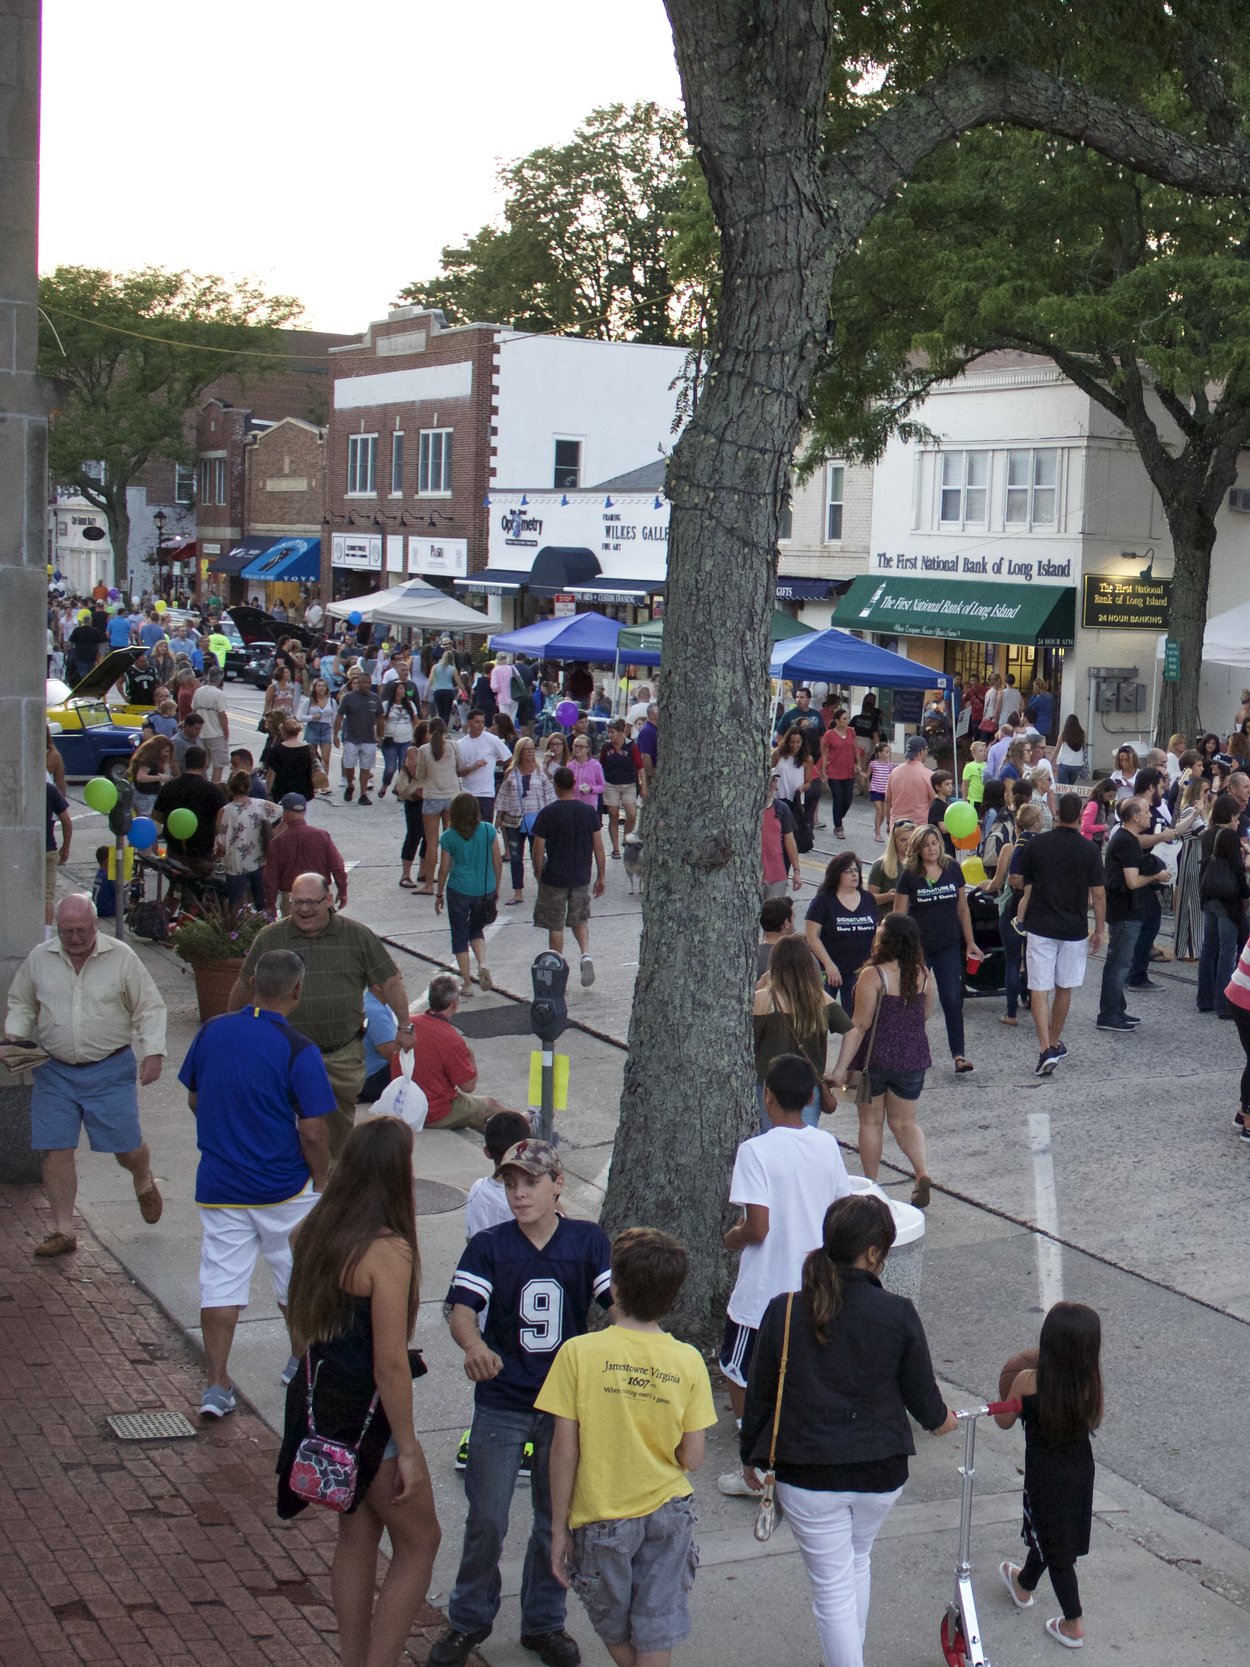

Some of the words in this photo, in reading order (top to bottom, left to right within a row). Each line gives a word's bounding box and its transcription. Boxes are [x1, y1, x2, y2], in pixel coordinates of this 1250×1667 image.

[602, 514, 621, 522] FRAMING
[605, 525, 636, 540] WILKES
[602, 542, 611, 550] FINE
[612, 543, 622, 551] ART
[877, 552, 893, 569] The
[896, 554, 918, 570] First
[922, 555, 959, 573] National
[962, 556, 988, 574] Bank
[992, 557, 1004, 574] of
[1008, 559, 1033, 582] Long
[1037, 558, 1071, 578] Island
[776, 586, 793, 597] GIFTS
[1099, 582, 1114, 593] The
[1114, 583, 1132, 593] First
[1135, 584, 1164, 594] National
[598, 594, 616, 602] CUSTOM
[616, 594, 636, 603] FRAMING
[1094, 594, 1112, 604] Bank
[1116, 594, 1124, 604] of
[1126, 596, 1144, 607] Long
[1146, 596, 1168, 606] Island
[880, 596, 896, 609] The
[894, 596, 913, 611] First
[912, 598, 944, 614] National
[940, 600, 963, 615] Bank
[961, 600, 975, 616] of
[970, 604, 992, 620] Long
[990, 604, 1022, 619] Island
[1098, 614, 1107, 622] 24
[1108, 614, 1129, 623] HOUR
[1130, 616, 1162, 624] BANKING
[1044, 638, 1060, 646] HOUR
[1056, 784, 1073, 793] HWY
[917, 885, 950, 894] SIGNATURE
[520, 1278, 563, 1352] 9
[602, 1360, 648, 1375] Jamestowne
[650, 1366, 680, 1384] Virginia
[628, 1376, 650, 1389] 1607
[604, 1386, 620, 1394] When
